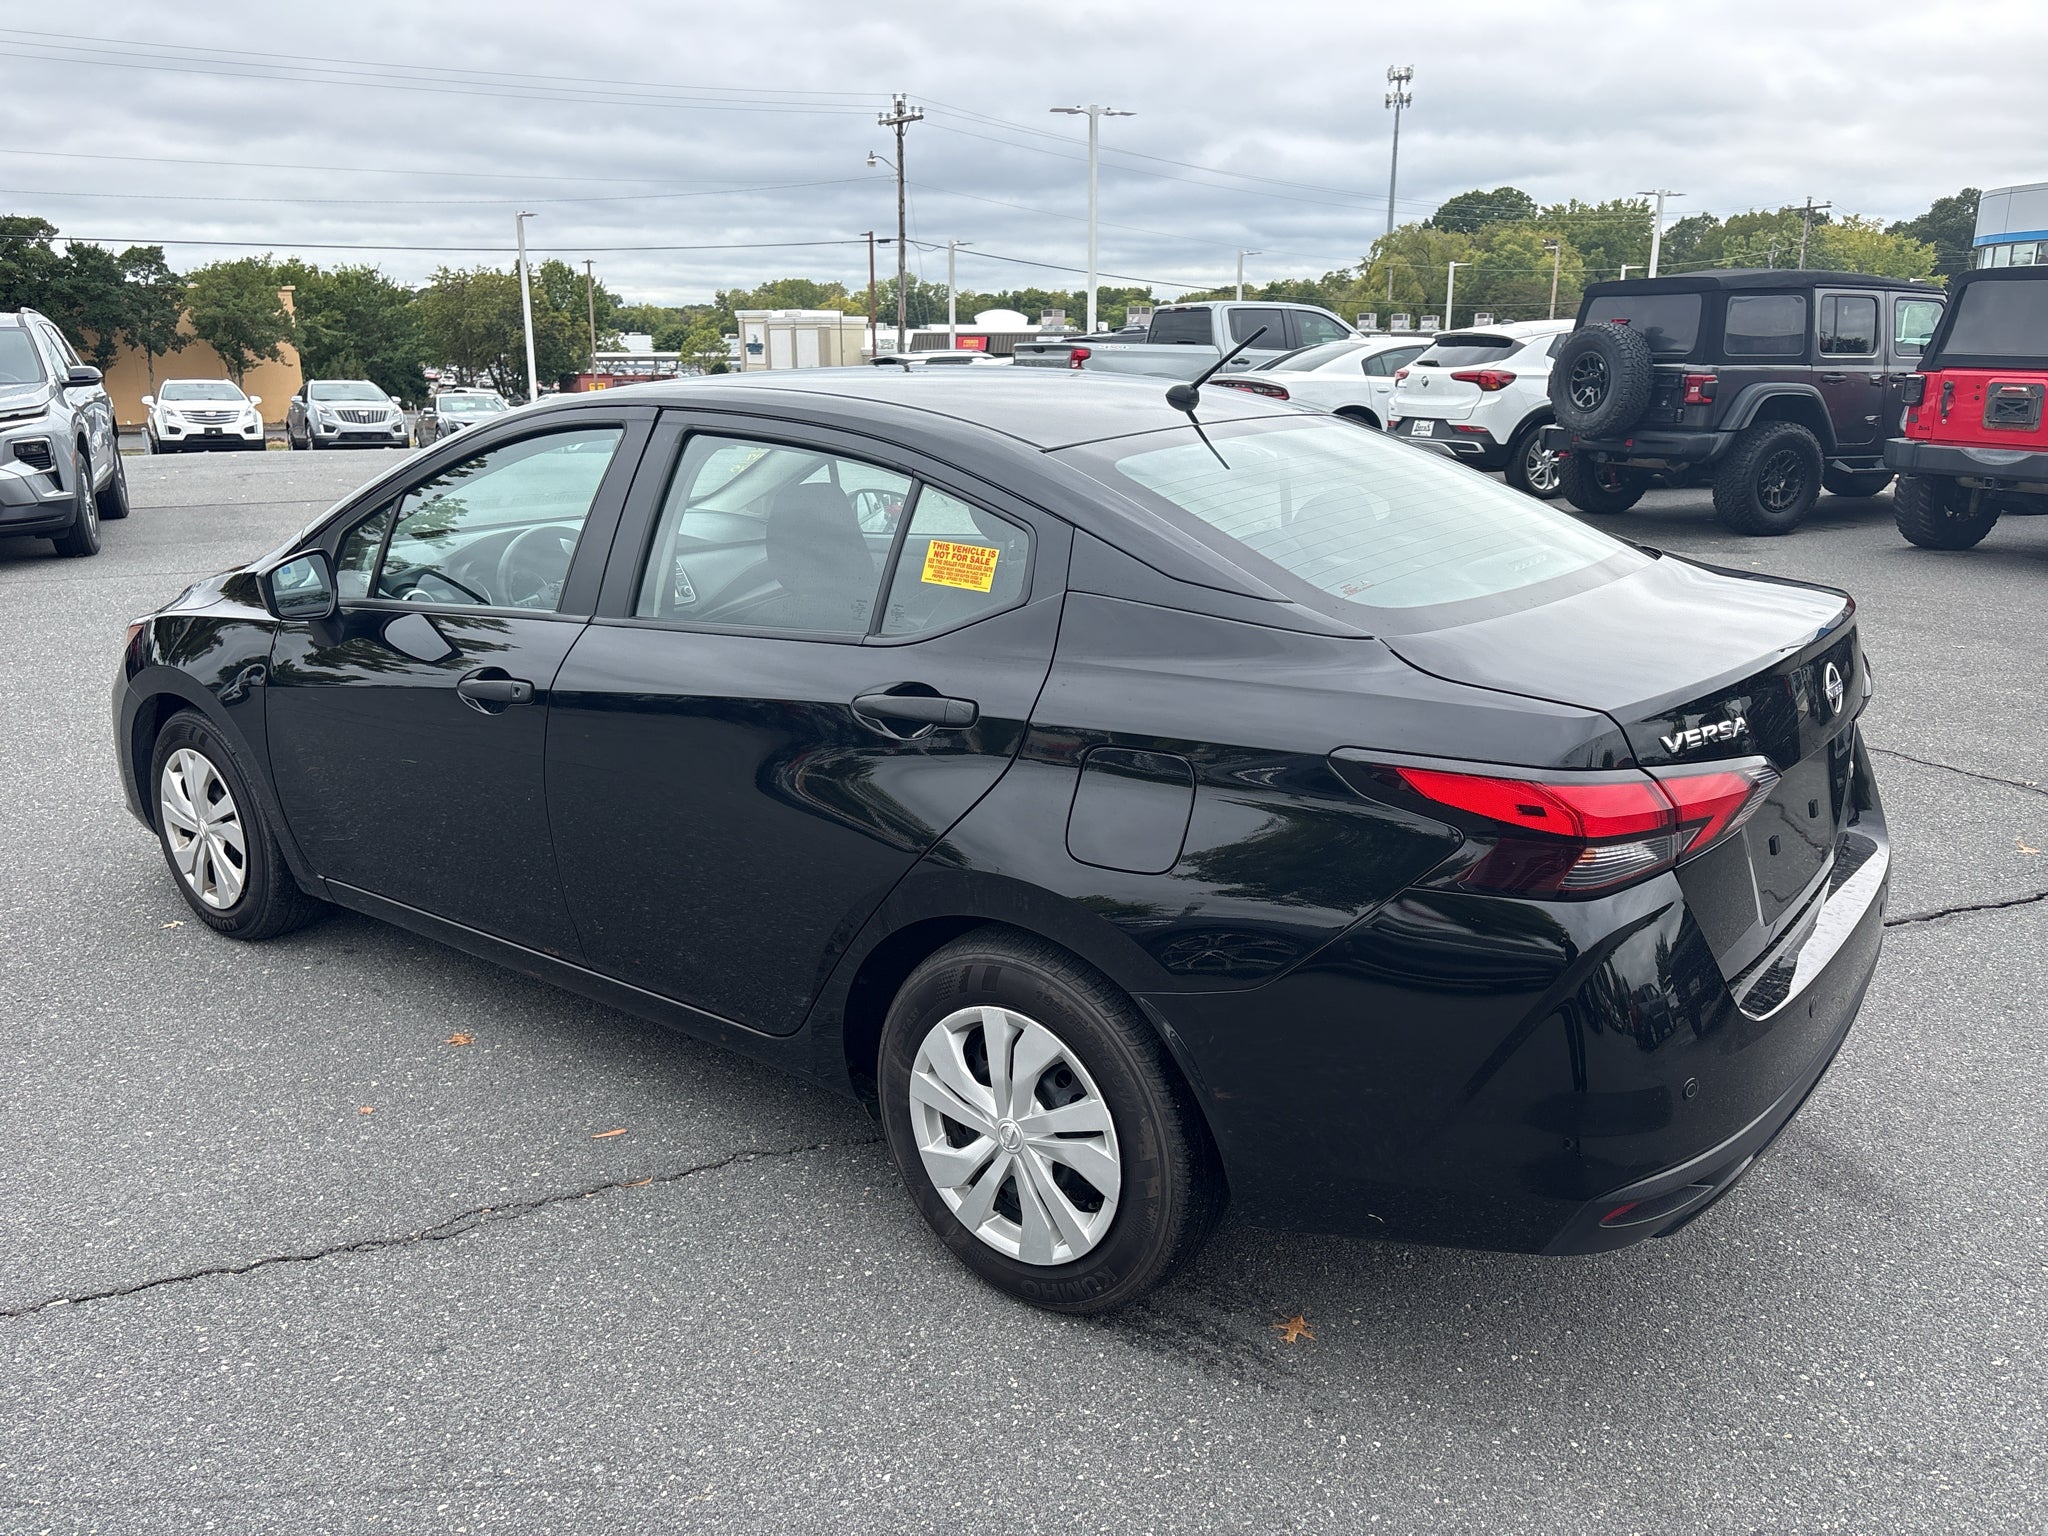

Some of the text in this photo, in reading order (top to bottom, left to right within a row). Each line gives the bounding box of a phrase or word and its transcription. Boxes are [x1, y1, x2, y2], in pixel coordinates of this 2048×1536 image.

[932, 542, 950, 551] THIS
[953, 545, 987, 557] VEHICLE
[934, 551, 991, 565] NOT FOR SALE
[1658, 716, 1749, 754] VERSA
